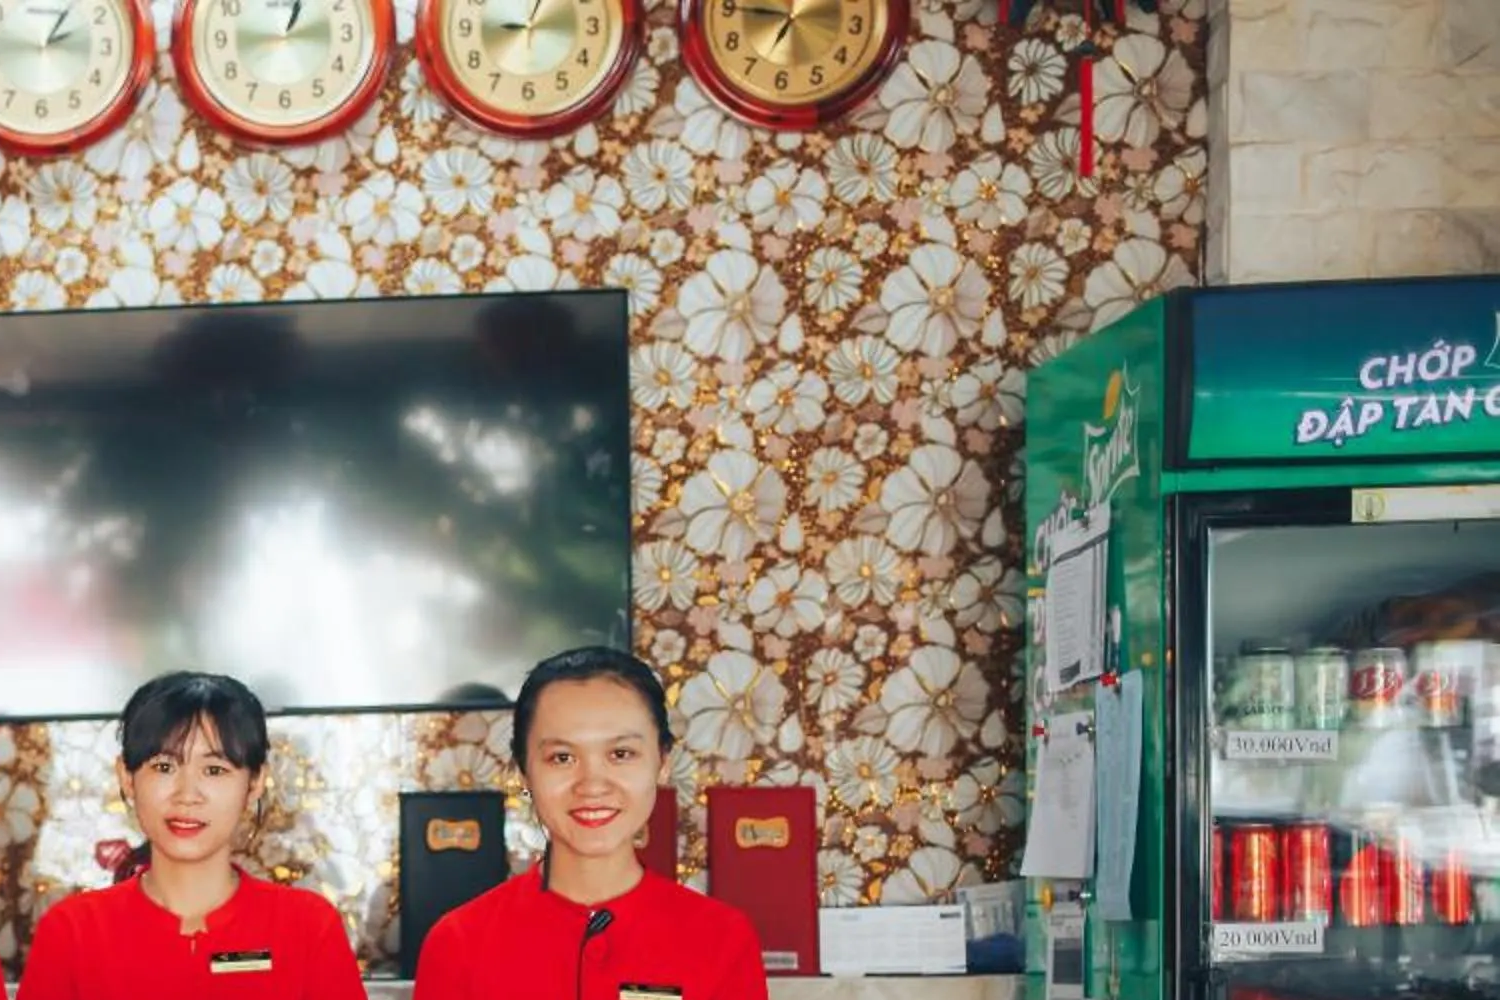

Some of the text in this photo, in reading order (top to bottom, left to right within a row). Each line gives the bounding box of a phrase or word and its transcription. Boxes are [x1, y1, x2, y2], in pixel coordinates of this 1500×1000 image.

[93, 6, 107, 25] 2
[222, 0, 241, 16] 10
[722, 0, 737, 18] 9
[340, 23, 354, 43] 3
[458, 18, 473, 38] 9
[586, 16, 600, 36] 3
[848, 15, 863, 36] 3
[99, 37, 113, 57] 3
[214, 29, 228, 49] 9
[725, 31, 740, 51] 8
[331, 54, 345, 74] 4
[467, 50, 481, 70] 8
[575, 48, 589, 67] 4
[833, 46, 848, 65] 4
[223, 61, 238, 80] 8
[743, 56, 758, 76] 7
[808, 65, 824, 86] 5
[88, 68, 102, 87] 4
[487, 73, 501, 92] 7
[555, 71, 569, 91] 5
[774, 70, 790, 91] 6
[245, 83, 259, 102] 7
[311, 78, 325, 98] 5
[520, 81, 535, 101] 6
[2, 89, 16, 109] 7
[34, 98, 49, 118] 6
[68, 90, 82, 110] 5
[278, 89, 292, 109] 6
[1359, 339, 1477, 390] CHỚP
[1297, 396, 1385, 447] ĐẬP
[1393, 387, 1476, 430] TAN
[1232, 736, 1331, 754] 30.000Vnd
[1219, 928, 1317, 947] 20000Vnd
